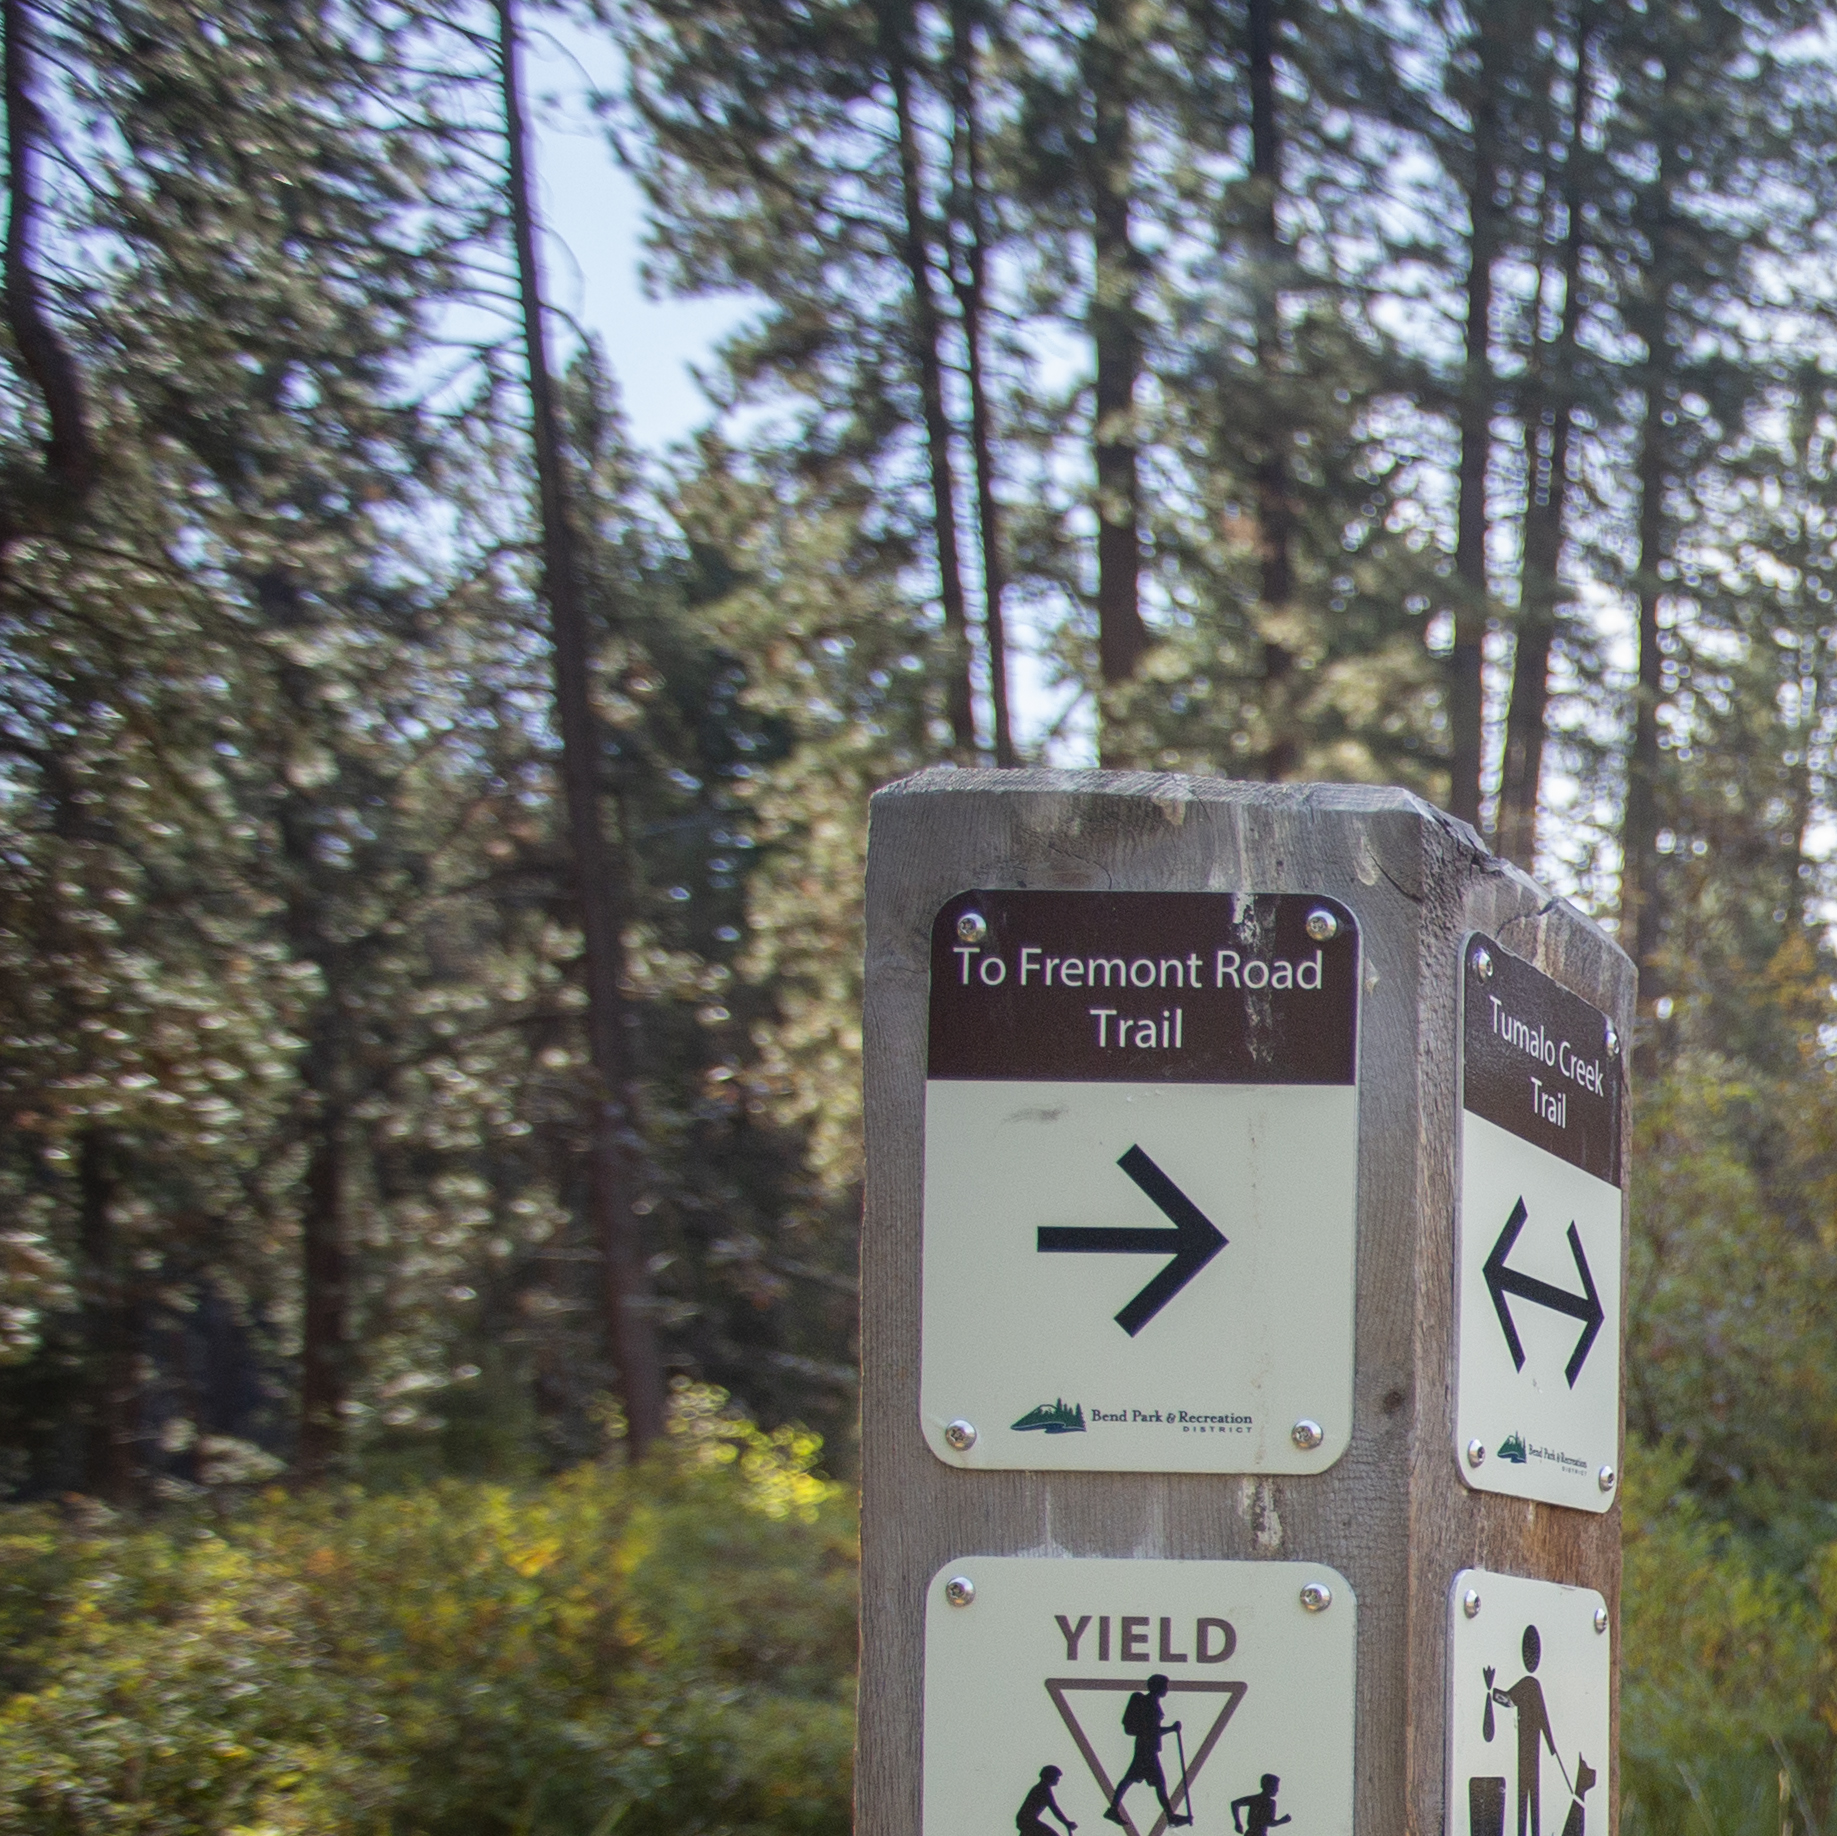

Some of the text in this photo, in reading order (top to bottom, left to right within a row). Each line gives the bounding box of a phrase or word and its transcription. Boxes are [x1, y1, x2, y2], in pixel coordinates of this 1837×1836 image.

[953, 947, 1323, 989] To Fremont Road
[1090, 1009, 1182, 1048] Trail
[1489, 995, 1603, 1097] Tumalo Creek
[1530, 1076, 1566, 1128] Trail
[1091, 1409, 1253, 1424] Bend Park & Recreation
[1054, 1615, 1237, 1663] YIELD
